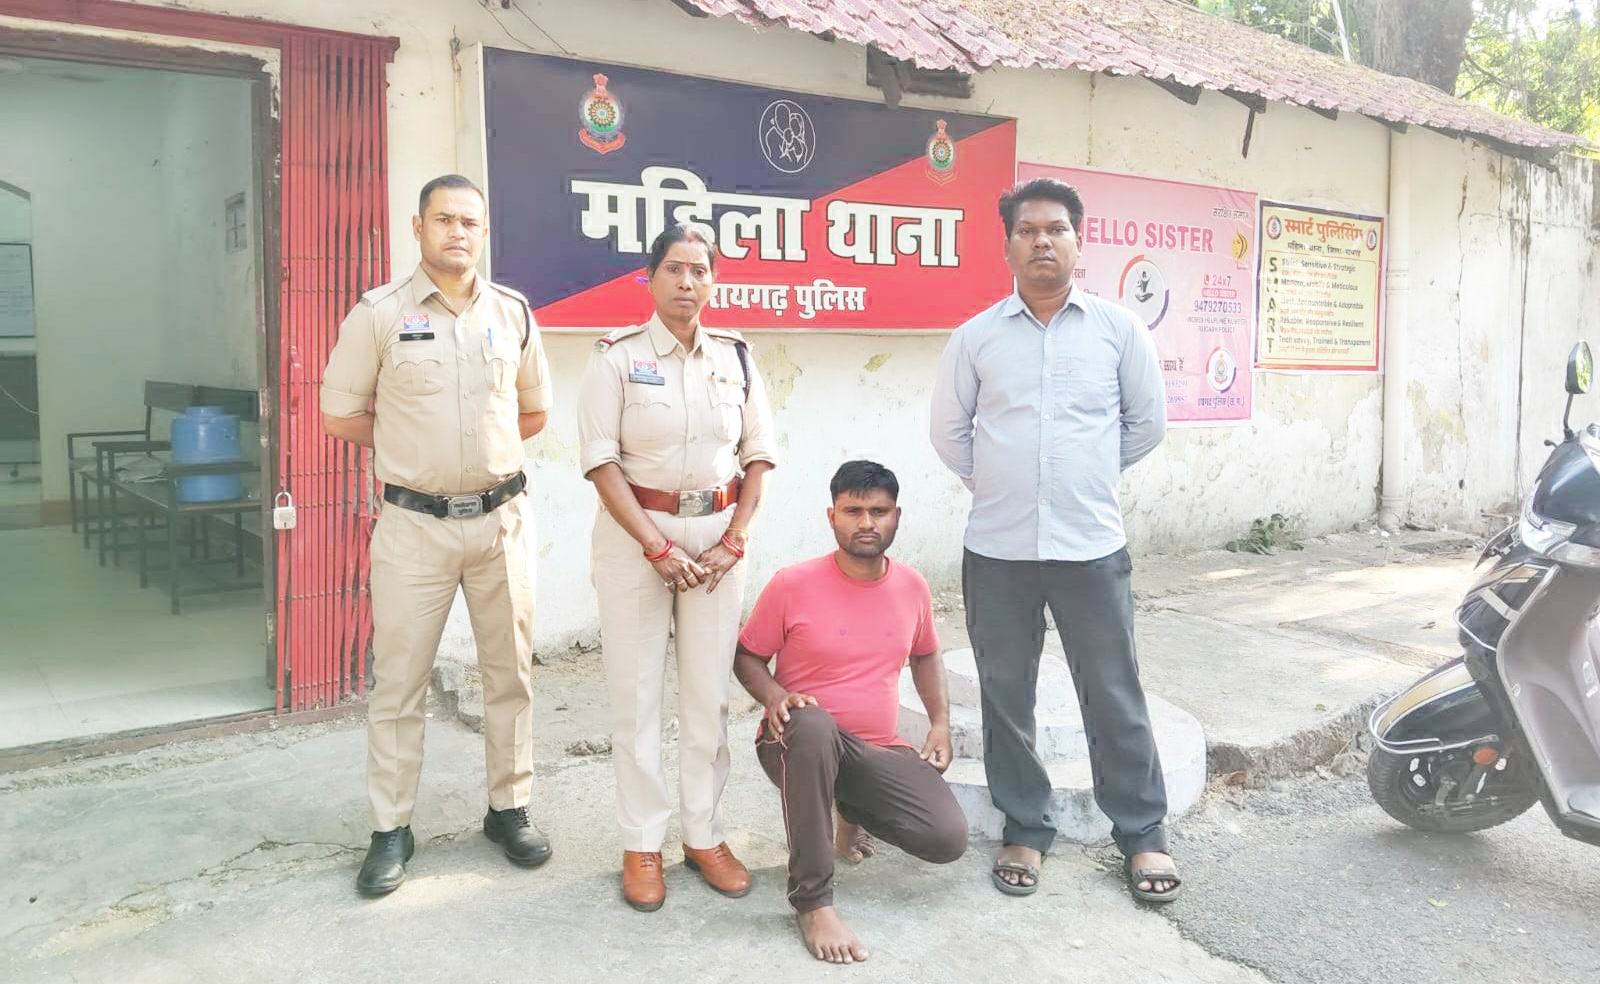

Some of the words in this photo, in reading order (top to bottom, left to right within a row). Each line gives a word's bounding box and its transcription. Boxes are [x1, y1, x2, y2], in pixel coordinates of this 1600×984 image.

[571, 166, 812, 262] महिला
[826, 200, 964, 267] थाना
[1284, 217, 1314, 236] स्मार्ट
[1145, 222, 1214, 253] SISTER
[1301, 260, 1327, 269] Sensitive
[1333, 263, 1356, 273] Strategic
[708, 283, 790, 317] रायगढ़
[794, 278, 867, 319] पुलिस
[1342, 320, 1364, 328] Resilient
[1313, 337, 1333, 345] Trained
[1339, 338, 1371, 348] Transparent
